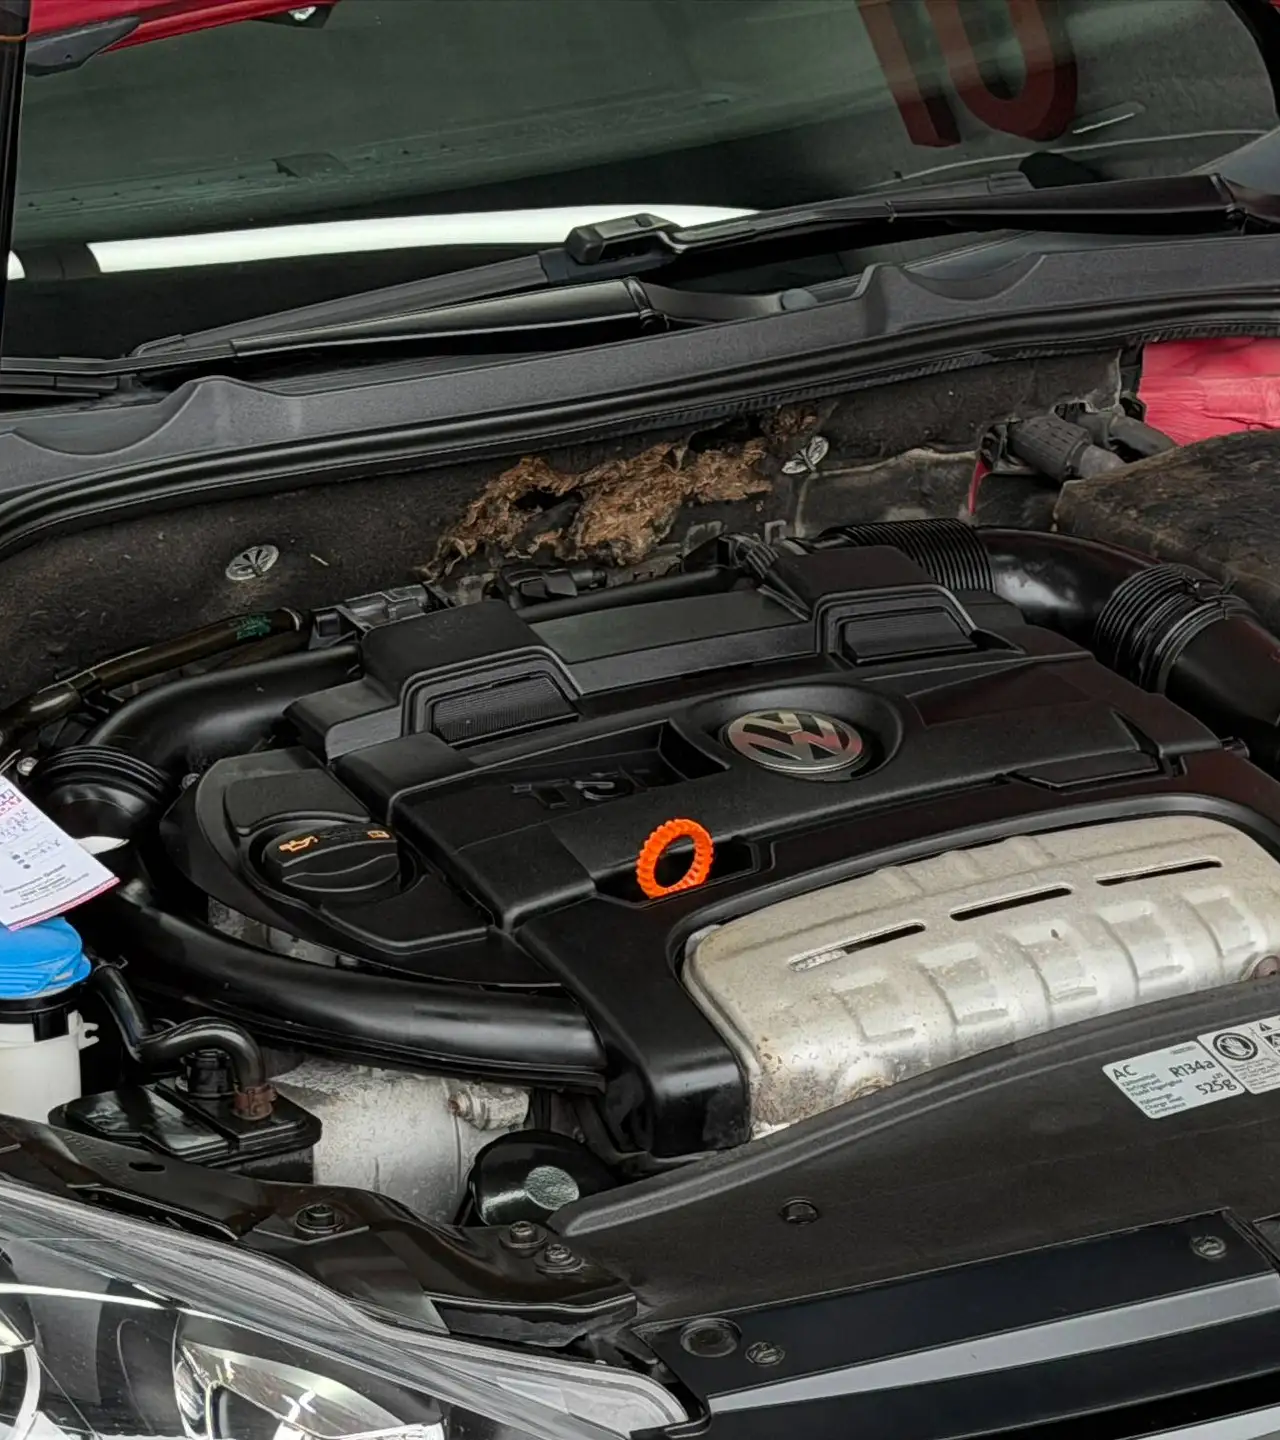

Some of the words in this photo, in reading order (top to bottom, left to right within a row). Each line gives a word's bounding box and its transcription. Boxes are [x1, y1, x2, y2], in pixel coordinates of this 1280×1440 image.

[1112, 1065, 1137, 1080] AC
[1169, 1060, 1216, 1078] R134a
[1196, 1079, 1238, 1096] 525g
